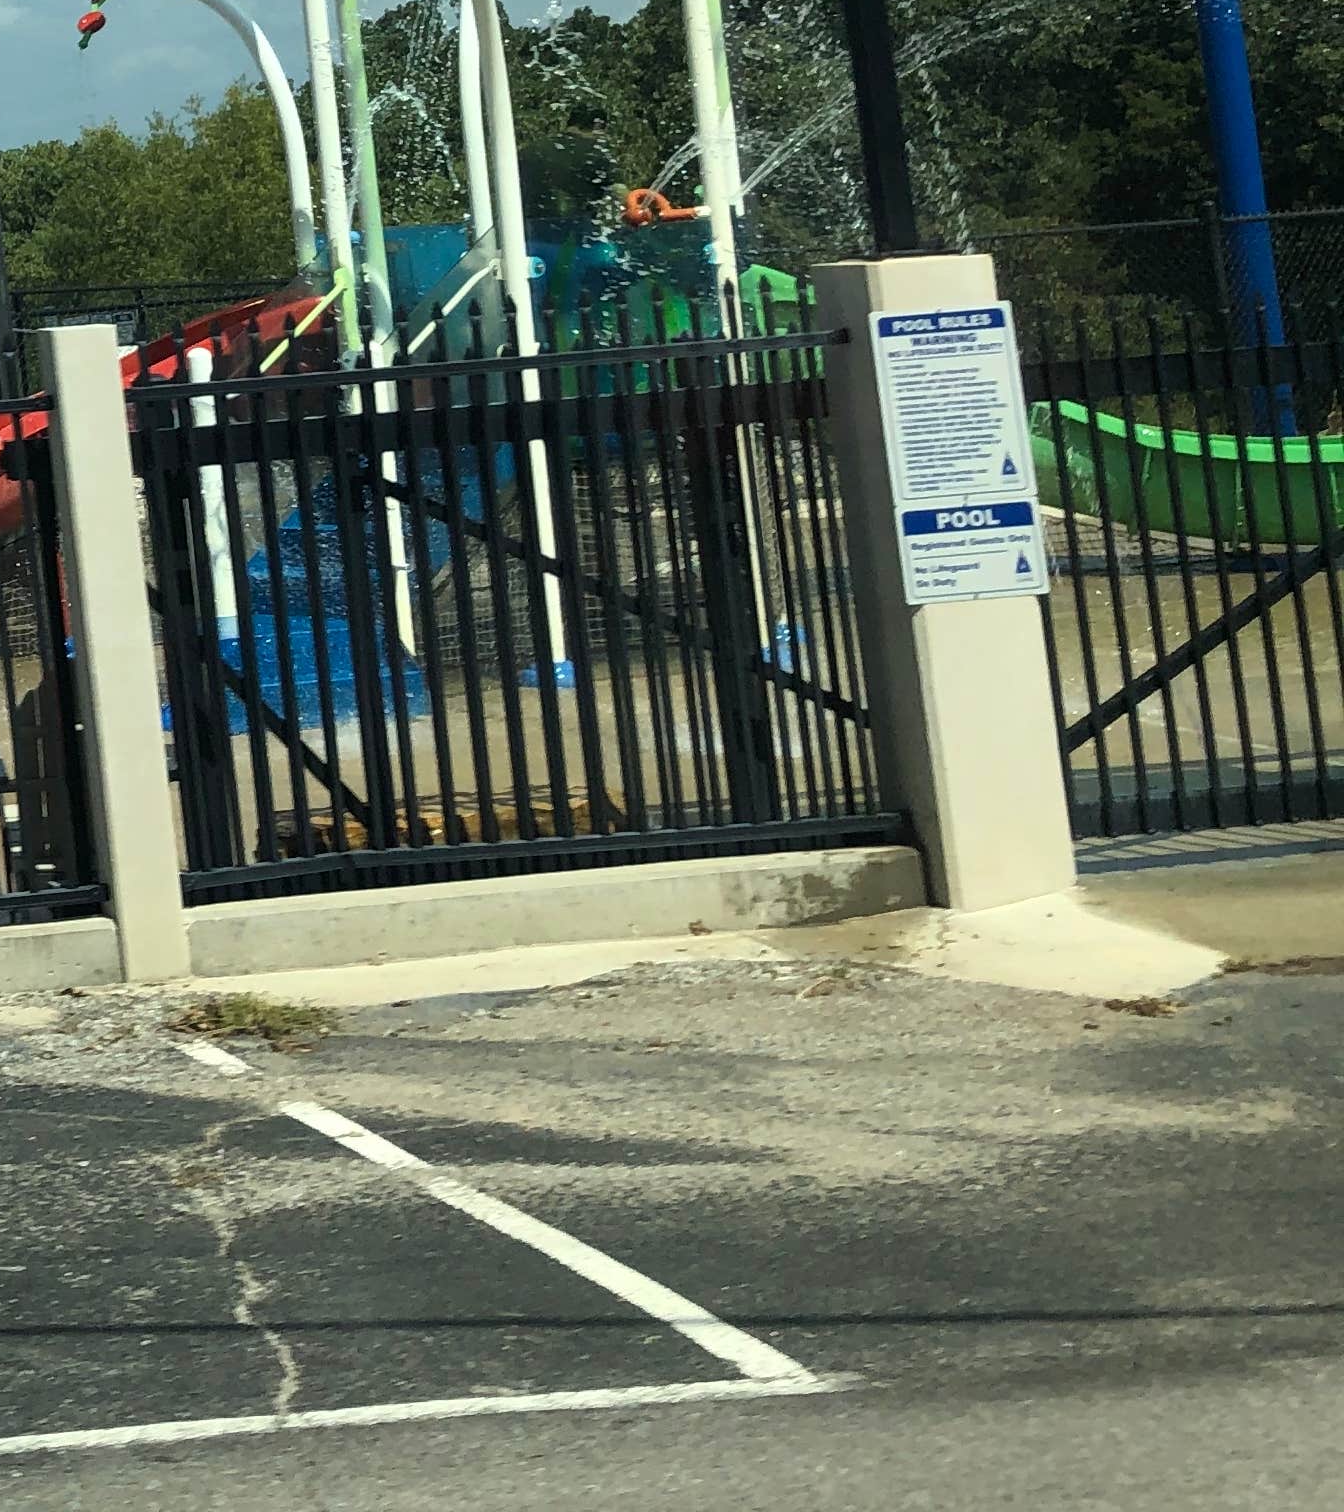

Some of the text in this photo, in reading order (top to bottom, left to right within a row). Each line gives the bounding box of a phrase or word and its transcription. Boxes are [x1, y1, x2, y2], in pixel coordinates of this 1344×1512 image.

[892, 314, 992, 333] POOL RULES
[911, 333, 977, 346] WARNING
[935, 509, 1001, 529] POOL
[911, 539, 966, 552] Registered
[930, 562, 980, 573] Lifeguard
